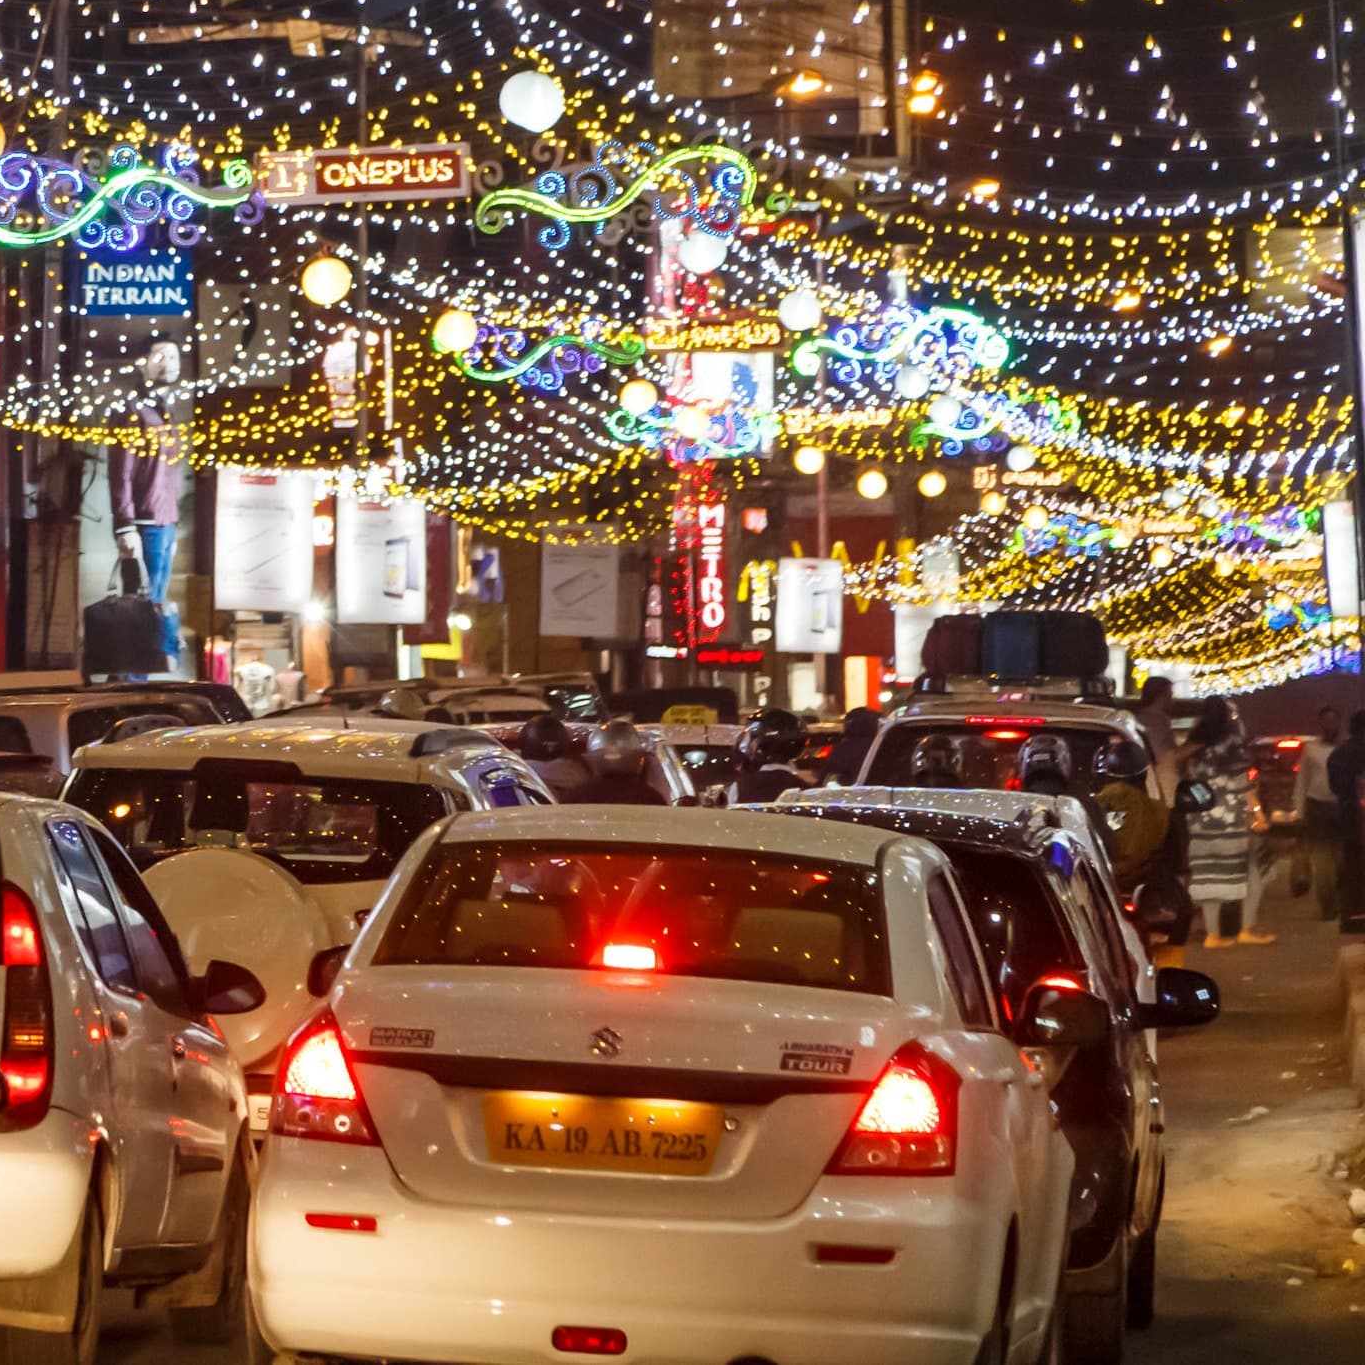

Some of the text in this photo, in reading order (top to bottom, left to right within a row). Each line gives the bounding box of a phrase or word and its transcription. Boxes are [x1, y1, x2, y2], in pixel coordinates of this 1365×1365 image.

[323, 157, 455, 187] ONEPLUS
[87, 263, 175, 283] INDIAN
[81, 283, 183, 306] TERRAIN
[698, 502, 726, 628] METRO
[786, 1058, 845, 1075] TOUR
[651, 1131, 708, 1162] 7225
